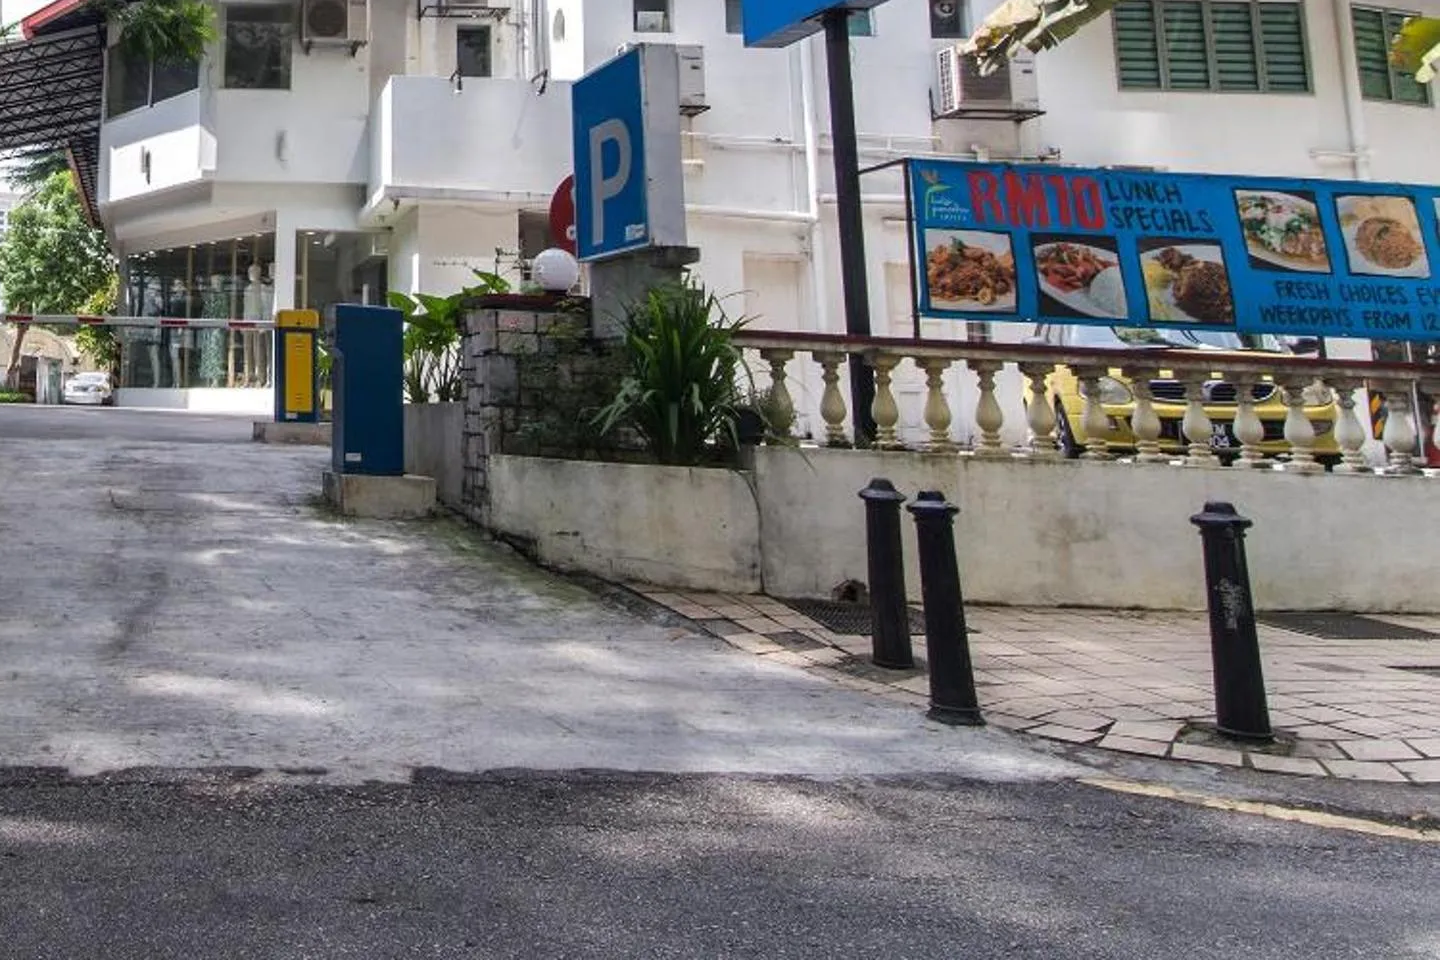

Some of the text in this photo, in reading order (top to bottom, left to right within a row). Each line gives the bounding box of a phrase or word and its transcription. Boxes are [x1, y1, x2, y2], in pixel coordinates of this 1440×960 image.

[589, 118, 632, 246] P
[1105, 179, 1183, 205] LUNCH
[967, 171, 1106, 229] RM10
[1110, 206, 1215, 233] SPECIALS
[1275, 280, 1329, 301] FRESH
[1340, 284, 1408, 306] CHOICES
[1260, 305, 1353, 328] WEEKDAYS
[1362, 310, 1411, 330] FROM
